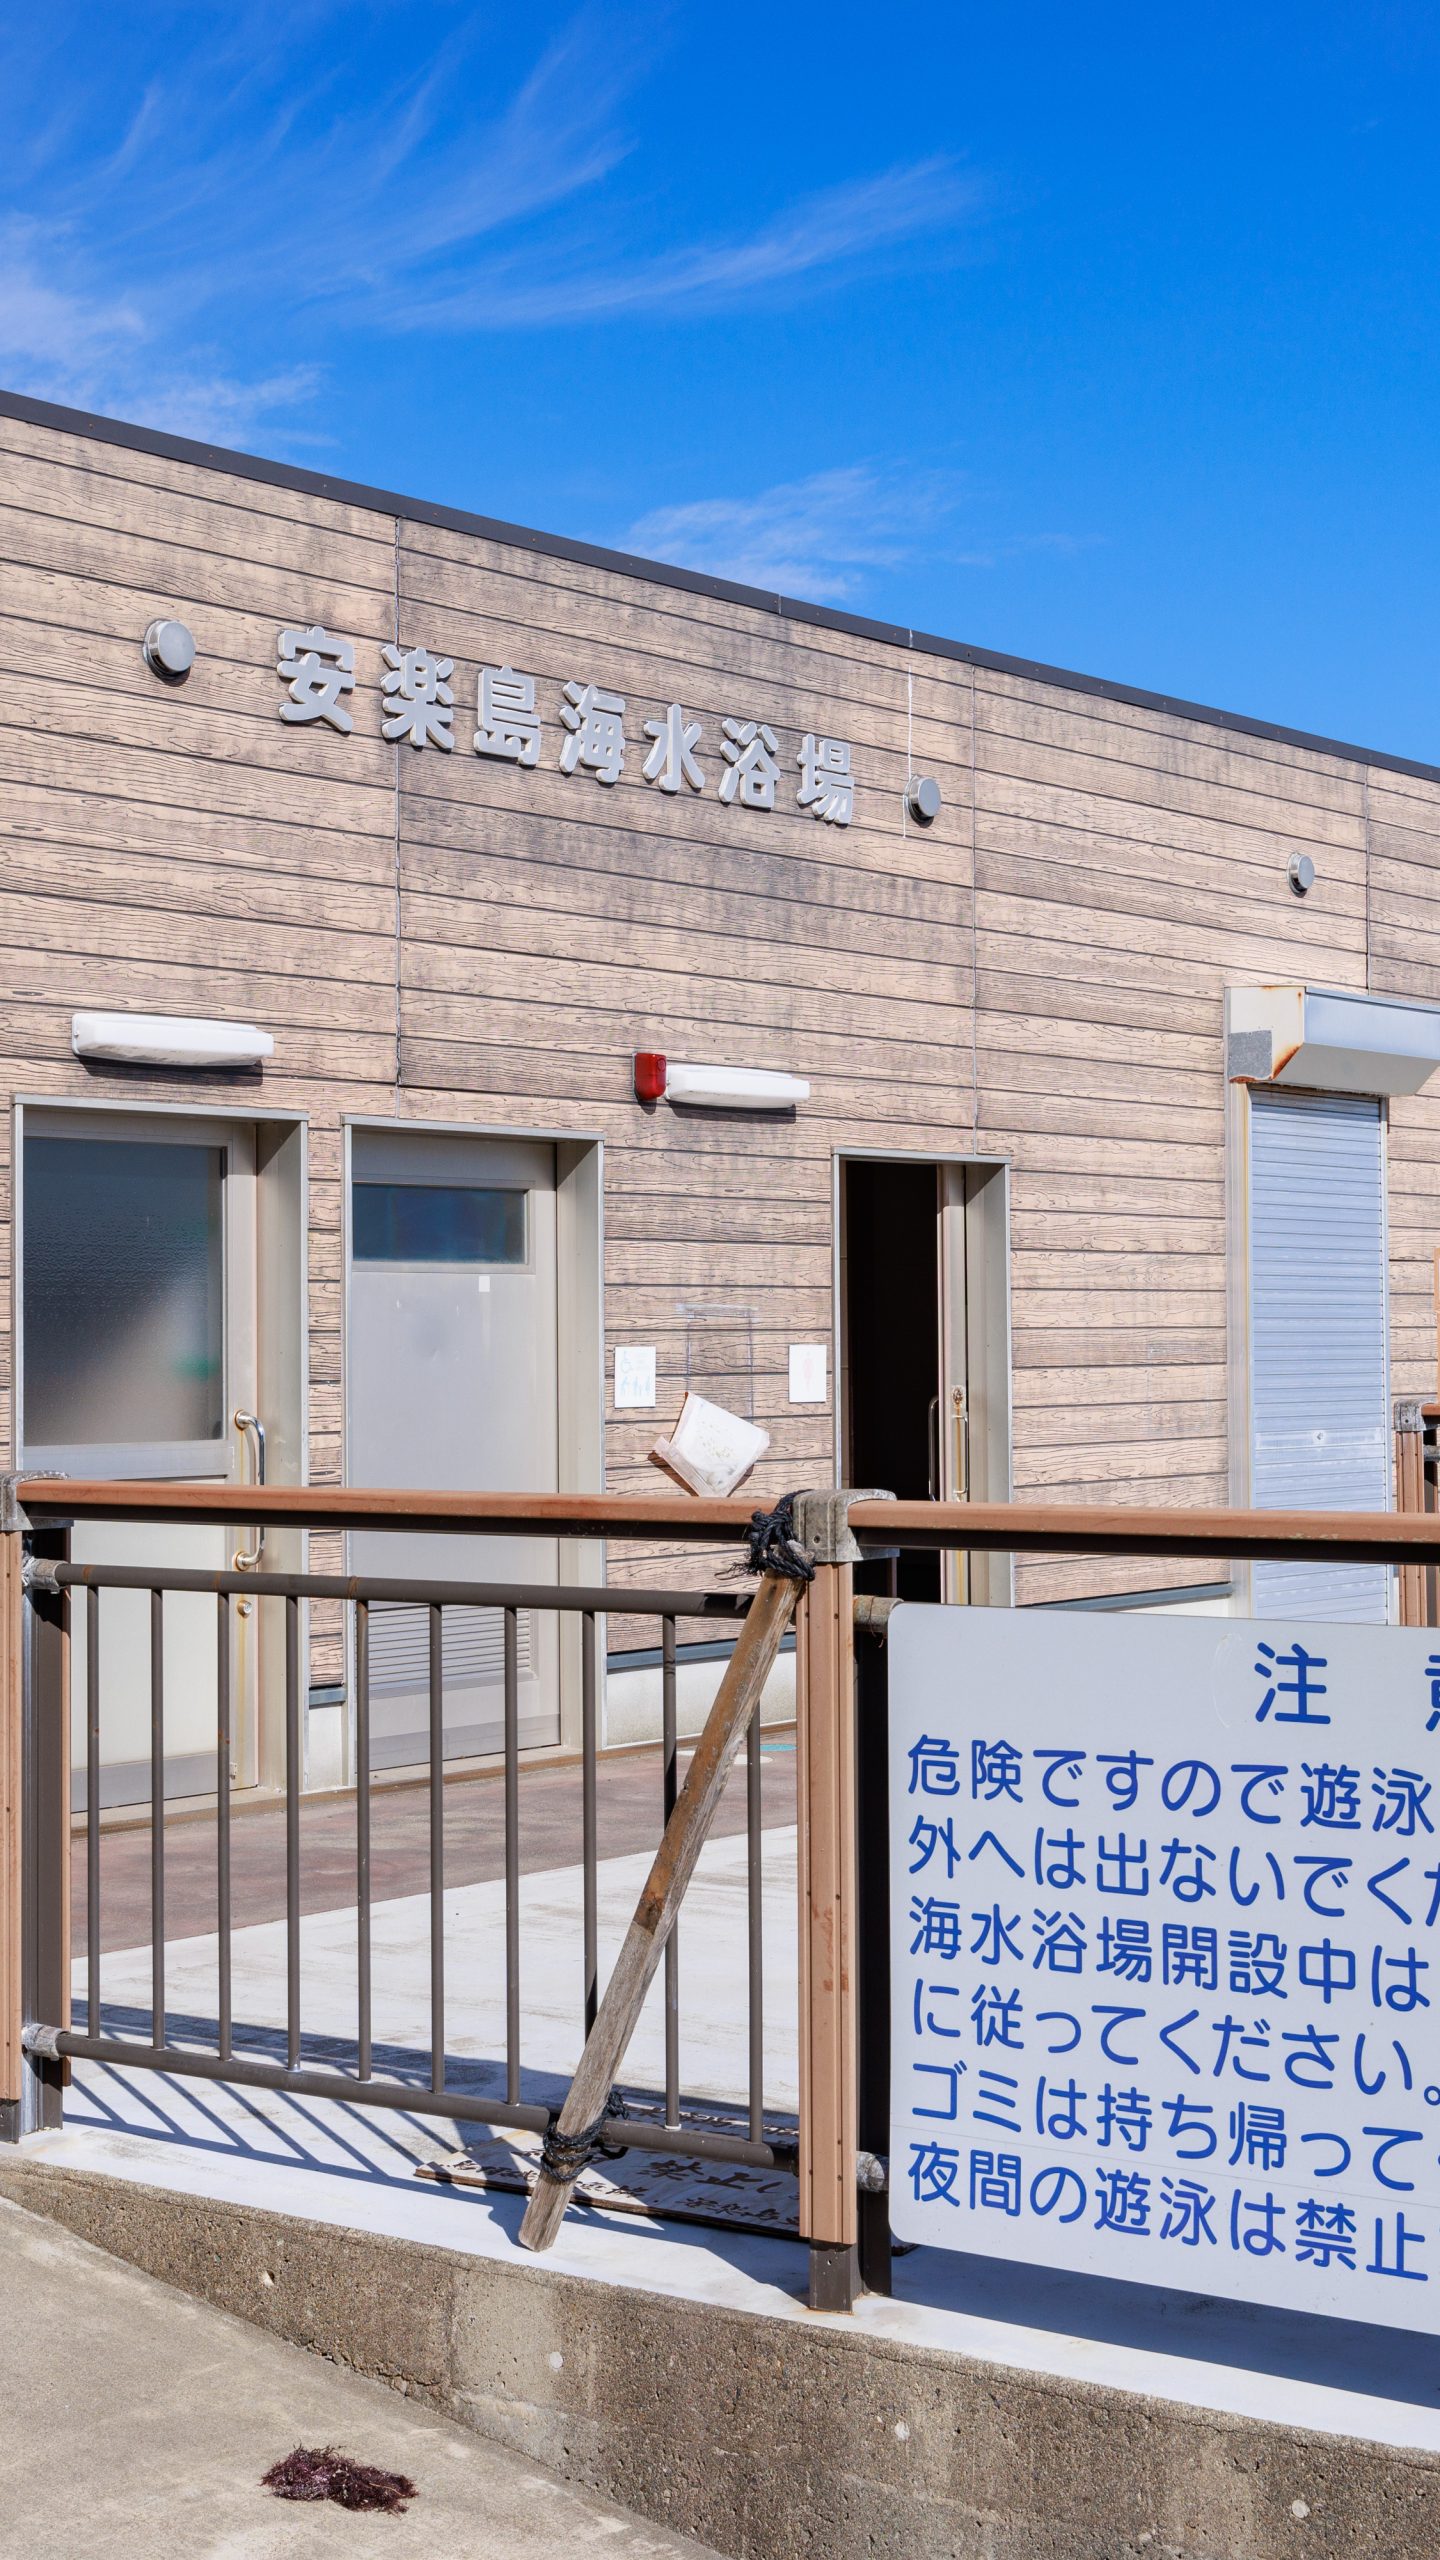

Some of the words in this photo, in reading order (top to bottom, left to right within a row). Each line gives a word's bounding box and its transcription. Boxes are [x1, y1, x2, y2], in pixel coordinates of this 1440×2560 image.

[276, 626, 857, 826] 安楽島海水浴場
[907, 1734, 1435, 1837] 危険ですので遊泳
[908, 1814, 1440, 1927] 外へは出ないでく
[909, 1896, 1431, 2013] 海水浴場開設中は
[913, 1978, 1440, 2106] に従ってください。
[911, 2060, 1440, 2192] ゴミは持ち帰って
[907, 2141, 1430, 2282] 夜間の遊泳は禁止
